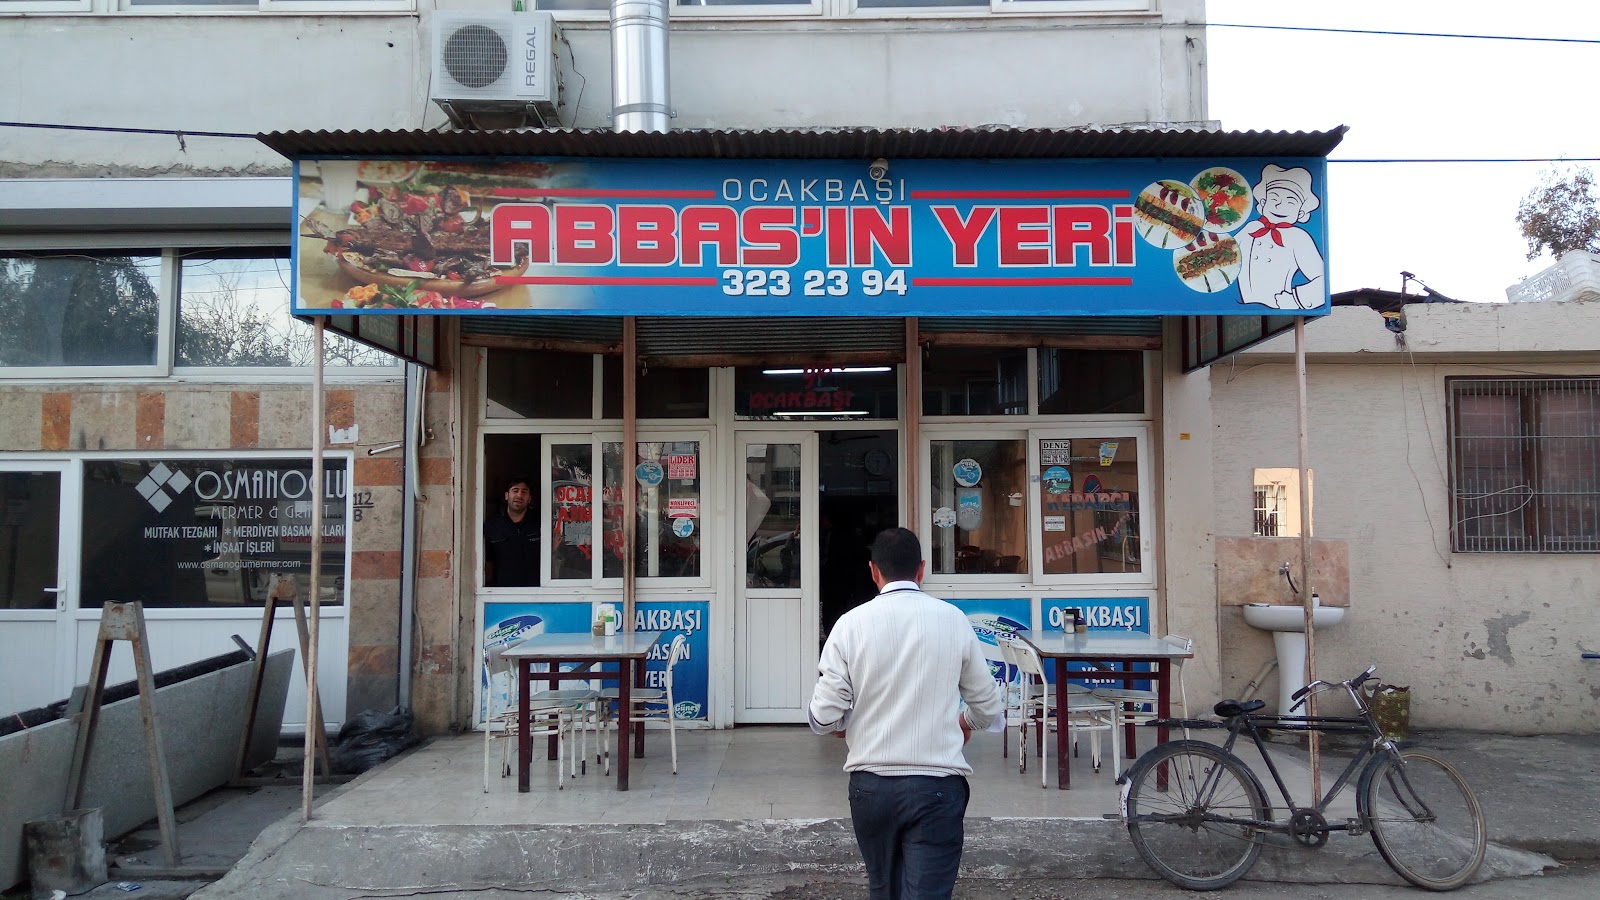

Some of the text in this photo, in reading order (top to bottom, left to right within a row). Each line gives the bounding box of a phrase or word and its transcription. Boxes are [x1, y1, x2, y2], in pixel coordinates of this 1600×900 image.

[525, 26, 537, 87] REGAL
[722, 178, 907, 205] OCAKBAŞI
[490, 202, 914, 268] ABBAS'IN
[722, 269, 908, 296] 323 23 94
[195, 469, 347, 500] OSMANOLU
[210, 505, 263, 519] MERMER
[353, 492, 374, 505] 112
[144, 526, 180, 538] MUTFAK
[181, 526, 218, 538] TEZGAHI
[233, 523, 279, 537] MERDİVEN
[213, 538, 244, 555] İNŞAAT
[246, 538, 275, 555] İŞLERİ
[177, 559, 301, 570] www.osmanoglumermer.com
[614, 609, 702, 636] OAKBAŞI
